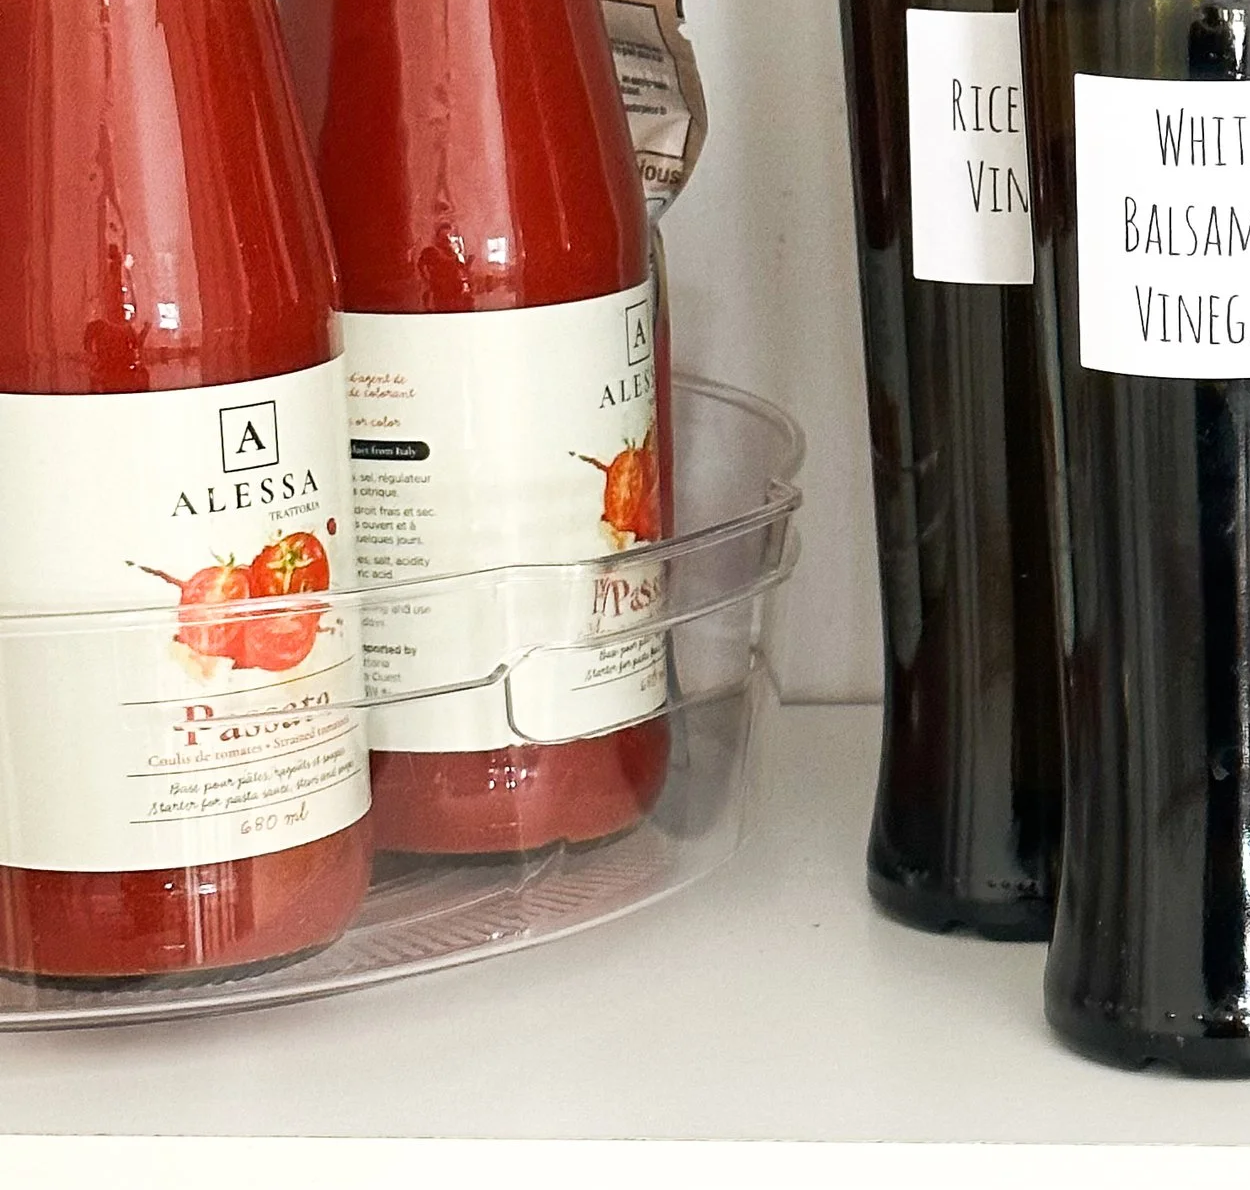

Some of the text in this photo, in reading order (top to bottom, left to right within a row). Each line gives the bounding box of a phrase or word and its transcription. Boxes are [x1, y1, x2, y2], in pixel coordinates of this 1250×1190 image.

[634, 317, 647, 349] A
[235, 420, 267, 454] A
[171, 469, 319, 517] ALESSA
[269, 501, 321, 522] TRATTORIA
[148, 751, 192, 767] Coulis
[148, 801, 199, 816] Starter
[240, 814, 278, 835] 680
